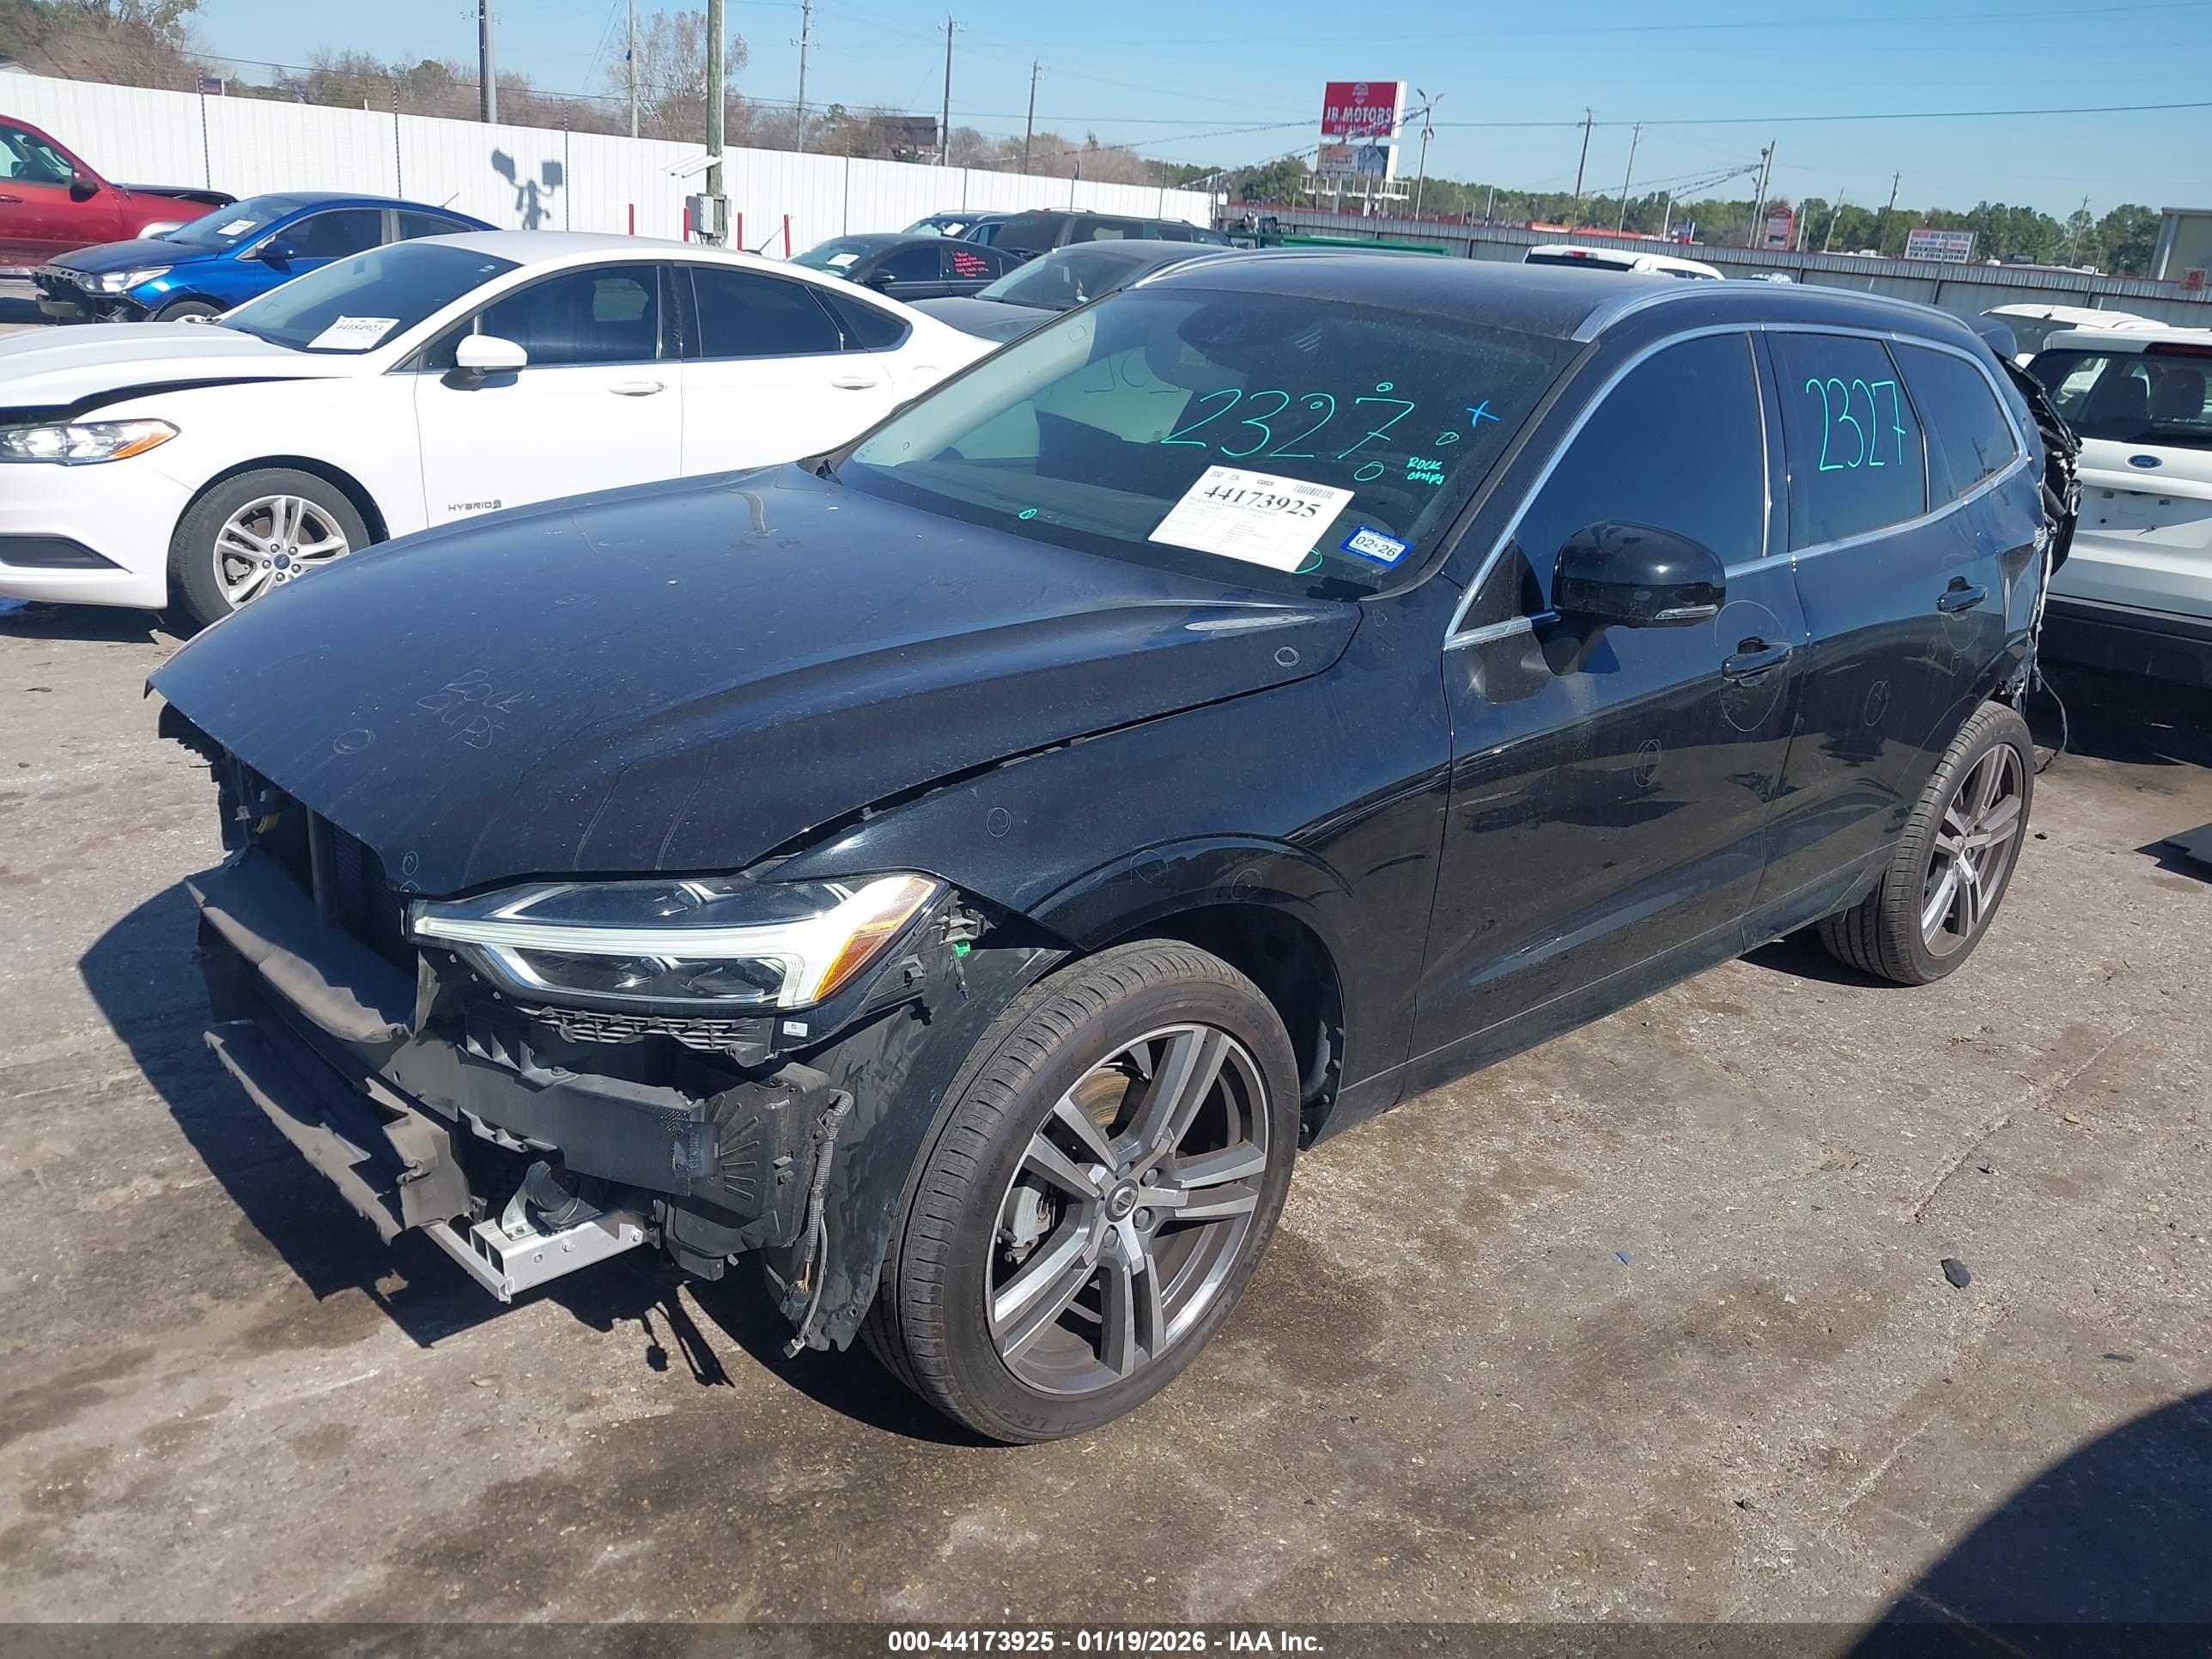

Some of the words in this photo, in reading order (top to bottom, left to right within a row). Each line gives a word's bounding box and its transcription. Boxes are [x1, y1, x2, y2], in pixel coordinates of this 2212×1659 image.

[1160, 388, 1416, 460] 2327
[1806, 377, 1906, 471] 2327
[447, 501, 493, 512] HYBRID
[1204, 483, 1322, 519] 44173925
